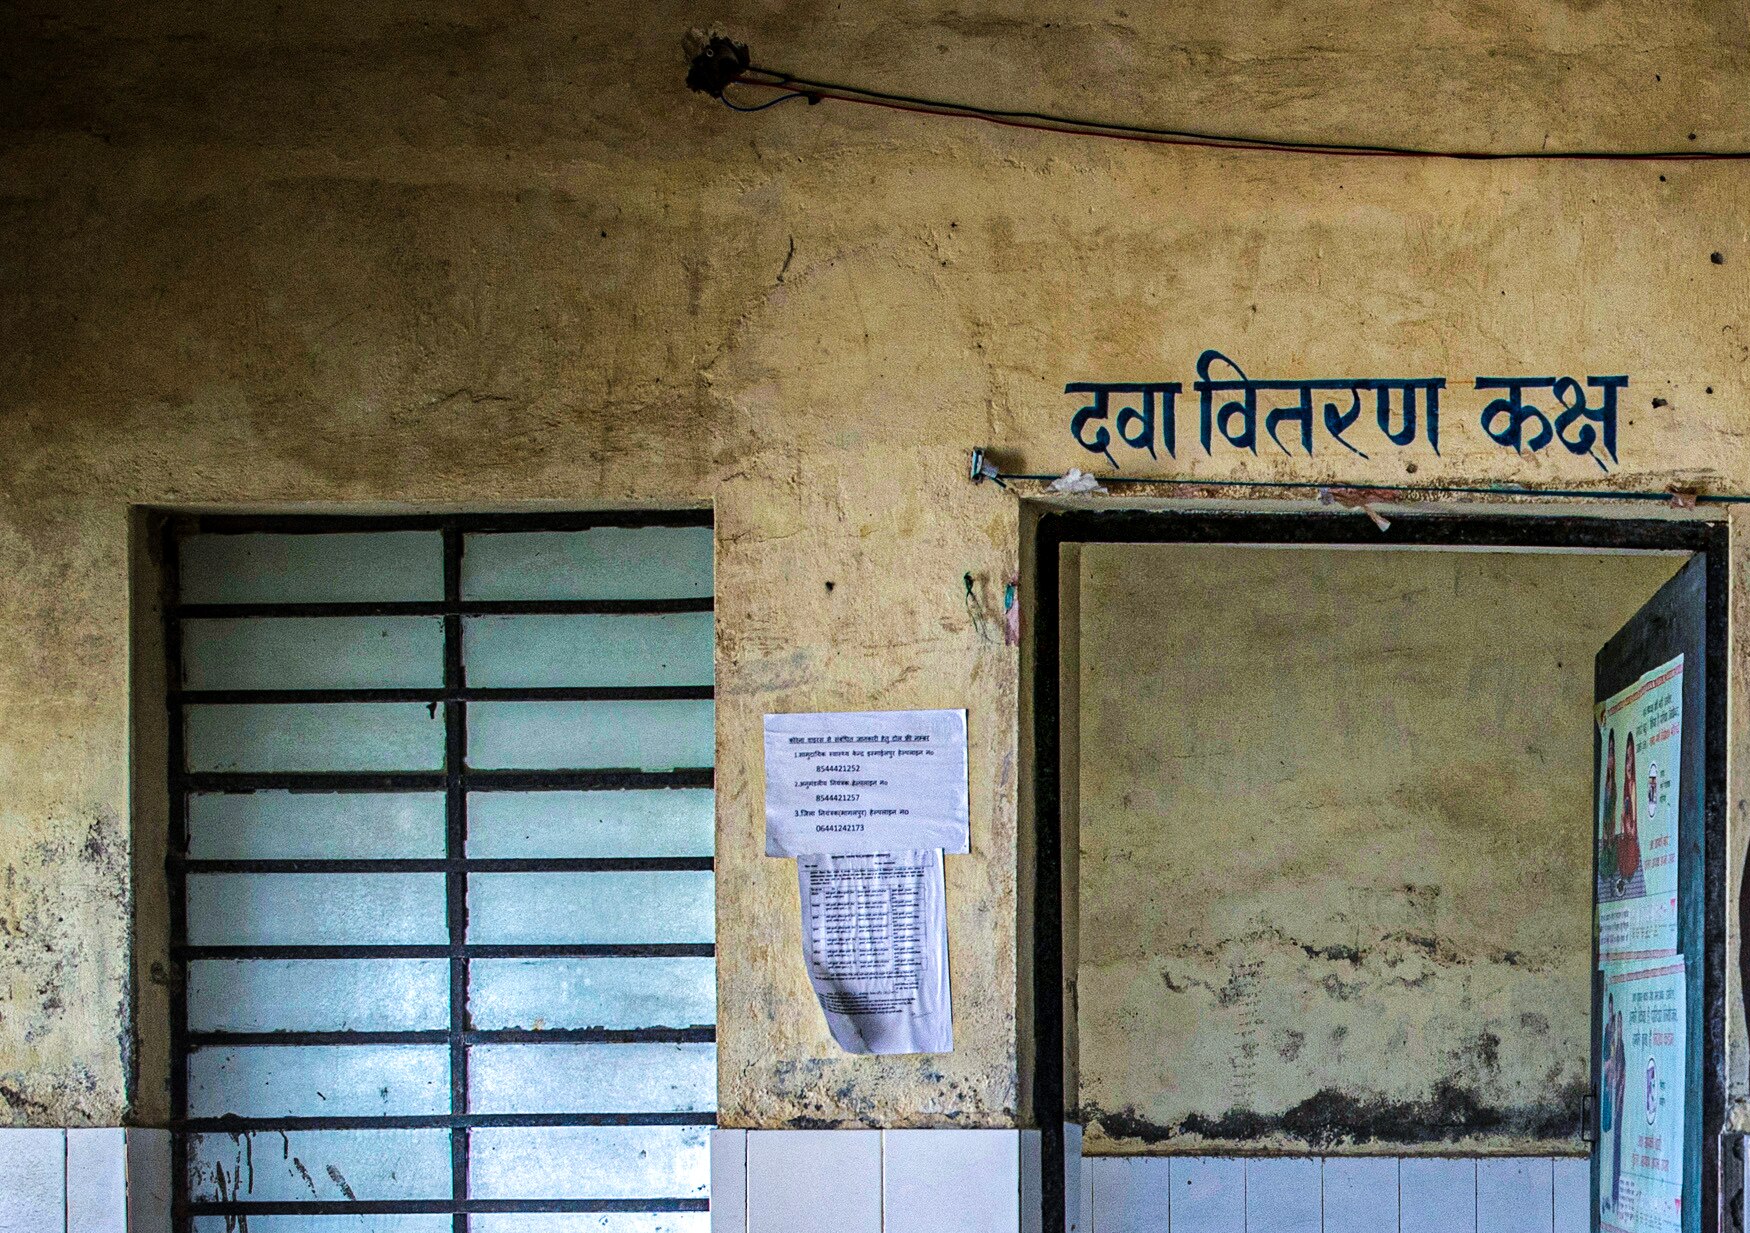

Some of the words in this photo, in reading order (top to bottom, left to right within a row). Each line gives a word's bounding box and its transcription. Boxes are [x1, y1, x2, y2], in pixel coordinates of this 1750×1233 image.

[1065, 382, 1182, 469] दवा
[1194, 350, 1446, 460] वितरण
[1474, 375, 1629, 472] कक्ष
